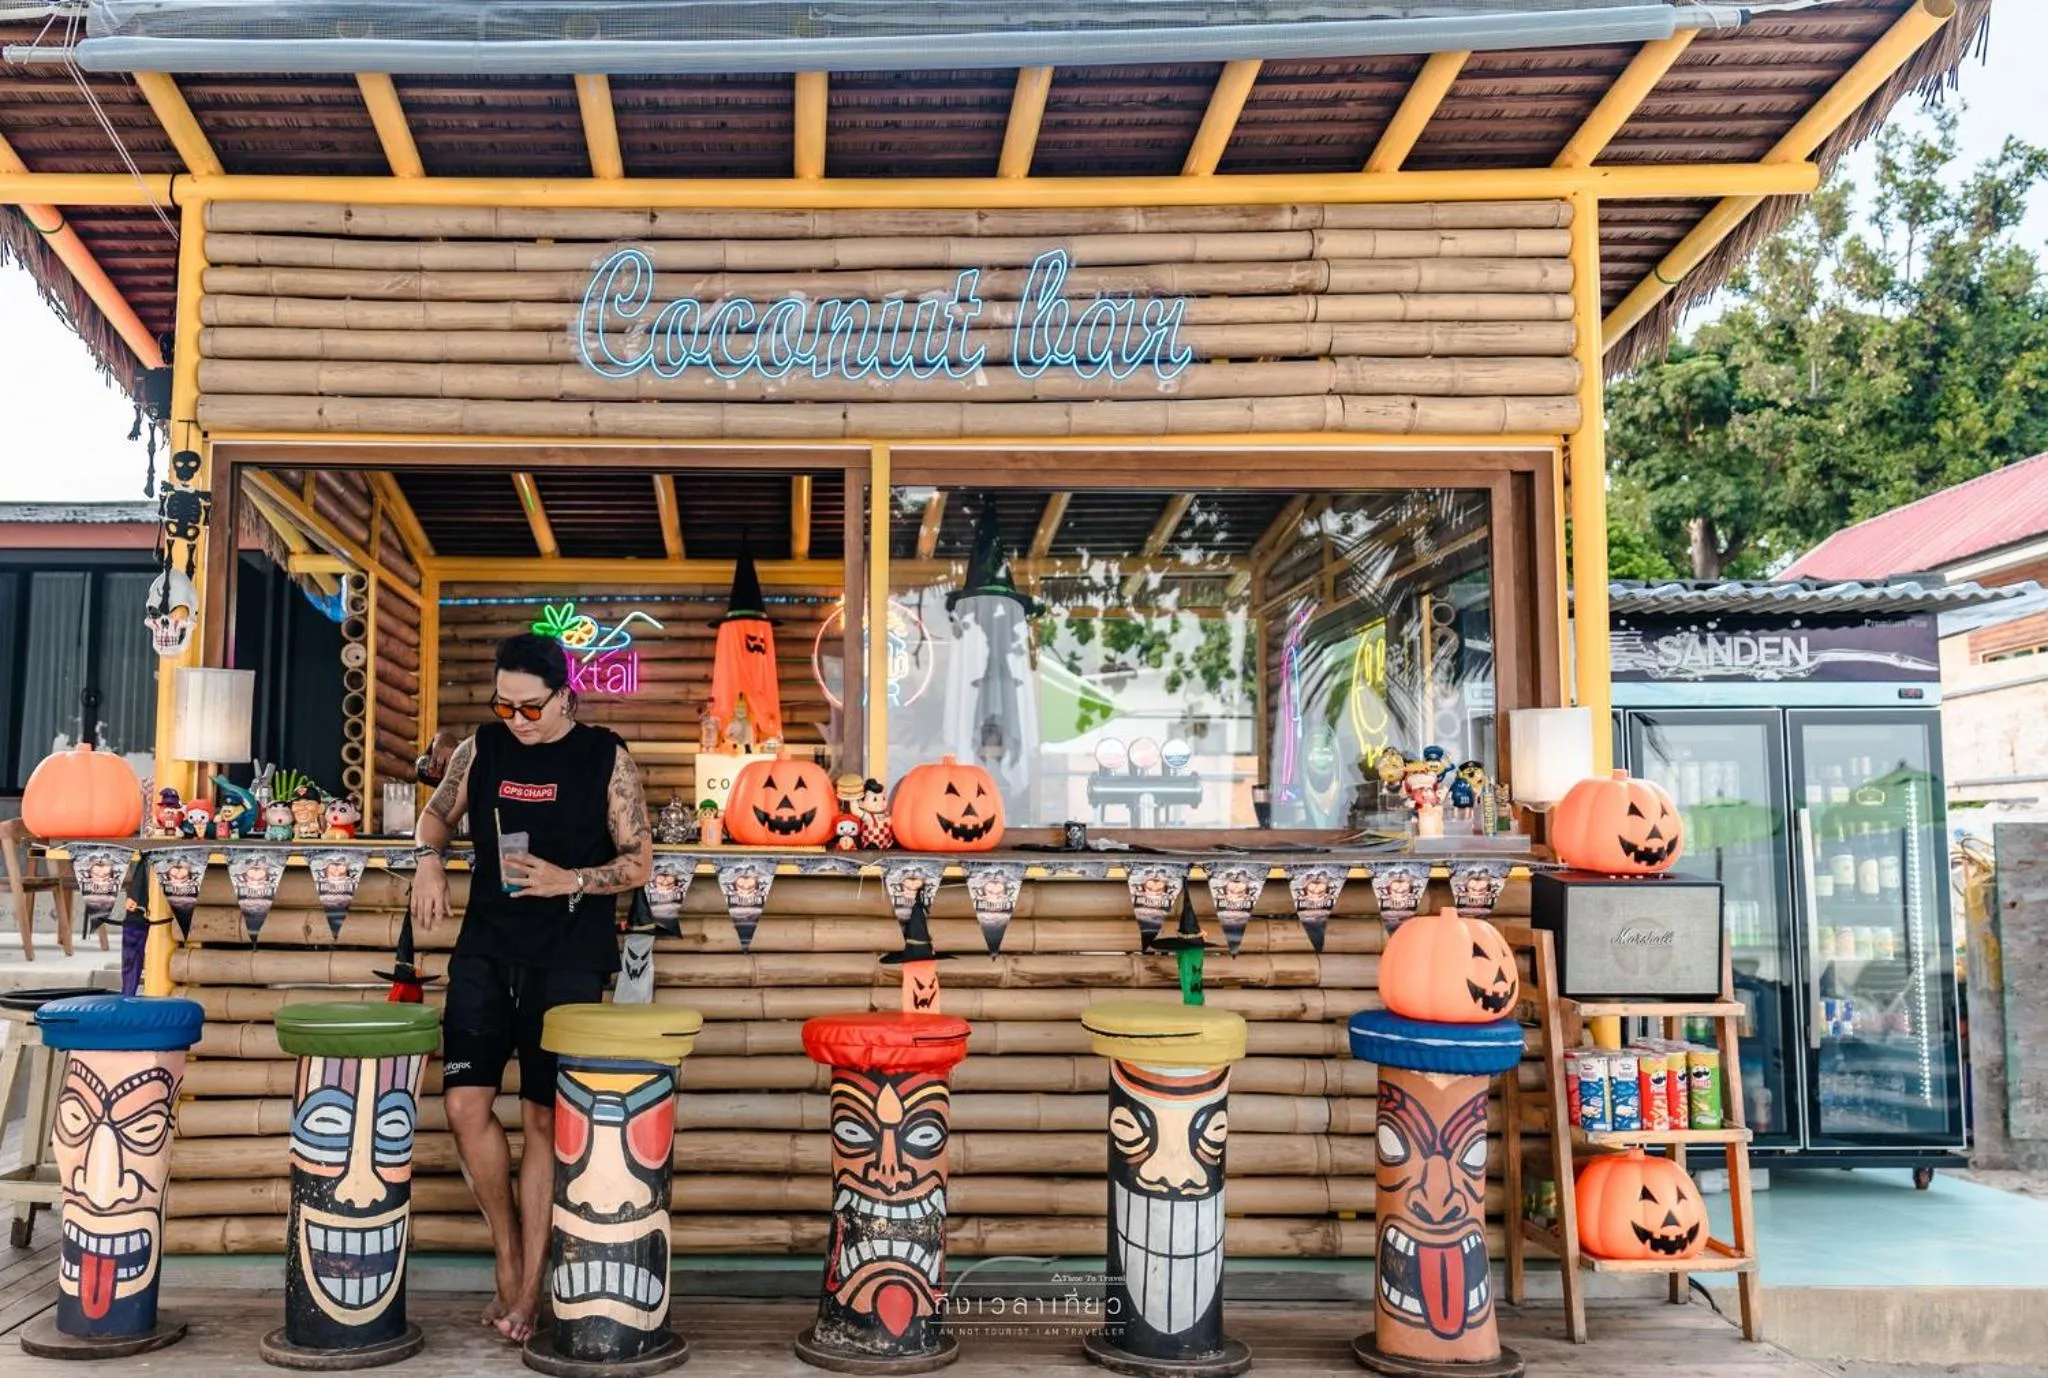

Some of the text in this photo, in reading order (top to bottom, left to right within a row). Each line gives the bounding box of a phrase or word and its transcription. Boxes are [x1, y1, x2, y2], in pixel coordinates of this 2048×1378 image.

[580, 249, 1192, 380] Coconut bar
[1657, 635, 1810, 667] SANDEN
[570, 651, 638, 693] ktail
[707, 778, 730, 790] CO
[1610, 927, 1674, 945] Marshall
